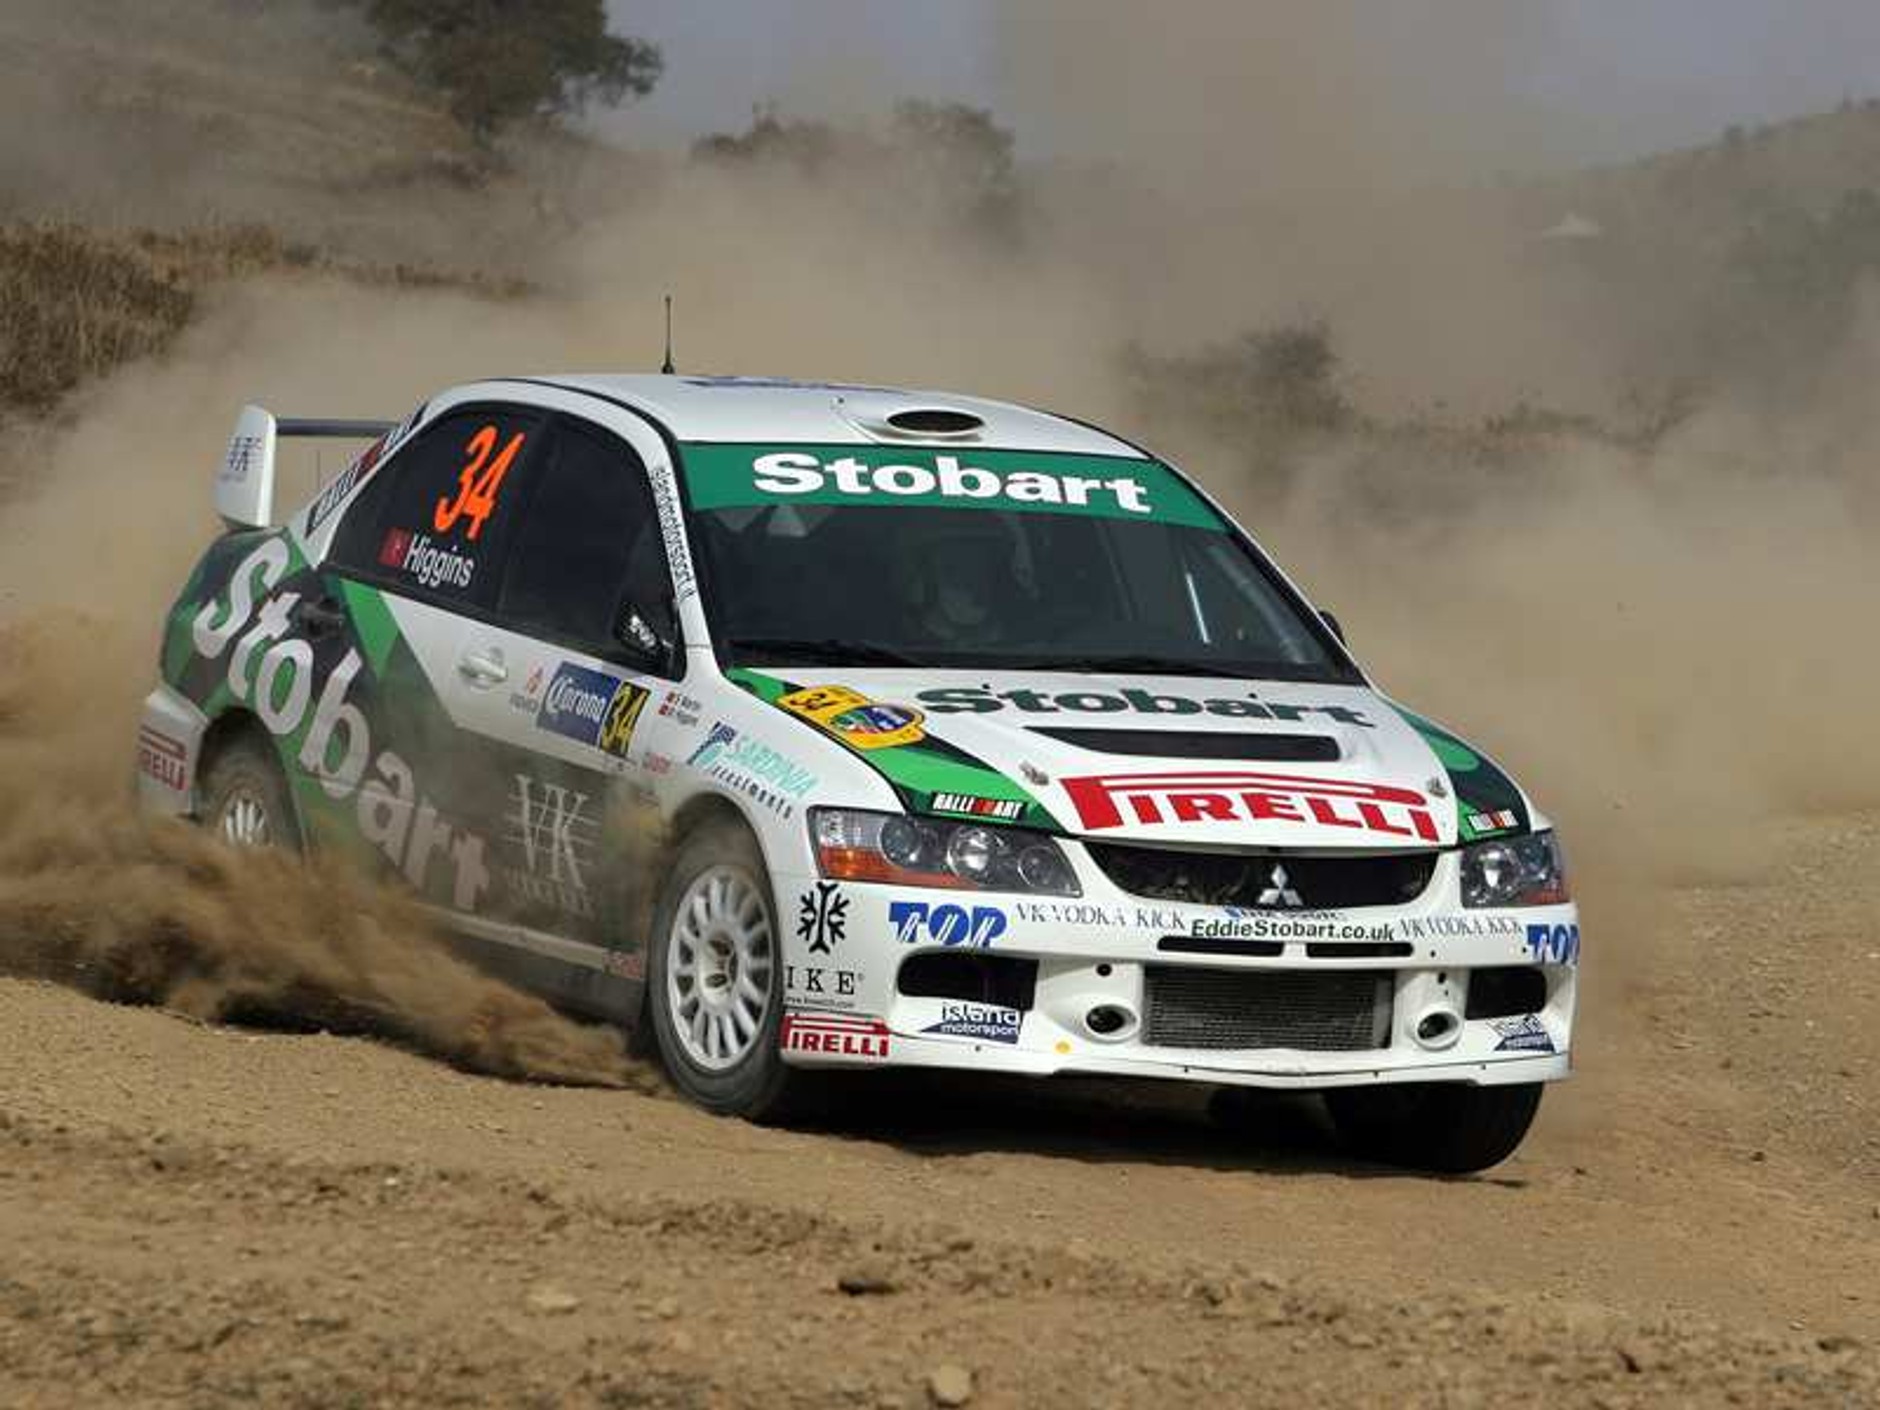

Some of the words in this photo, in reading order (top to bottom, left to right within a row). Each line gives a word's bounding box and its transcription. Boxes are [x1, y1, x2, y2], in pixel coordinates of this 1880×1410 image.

[433, 426, 525, 539] 34
[752, 452, 1153, 513] Stobart
[403, 532, 475, 588] Higgins
[545, 676, 607, 722] Corona
[603, 683, 648, 755] 34
[916, 686, 1375, 728] Stobart
[192, 536, 491, 911] Stobart
[1059, 771, 1440, 842] PIRELLI
[889, 902, 1007, 948] TOP
[1015, 903, 1046, 923] VK
[1050, 905, 1127, 927] VODKA
[1136, 907, 1187, 931] KICK
[1191, 919, 1395, 942] EddieStobart.co.uk
[1400, 918, 1426, 938] VK
[781, 1014, 890, 1058] PIRELLI
